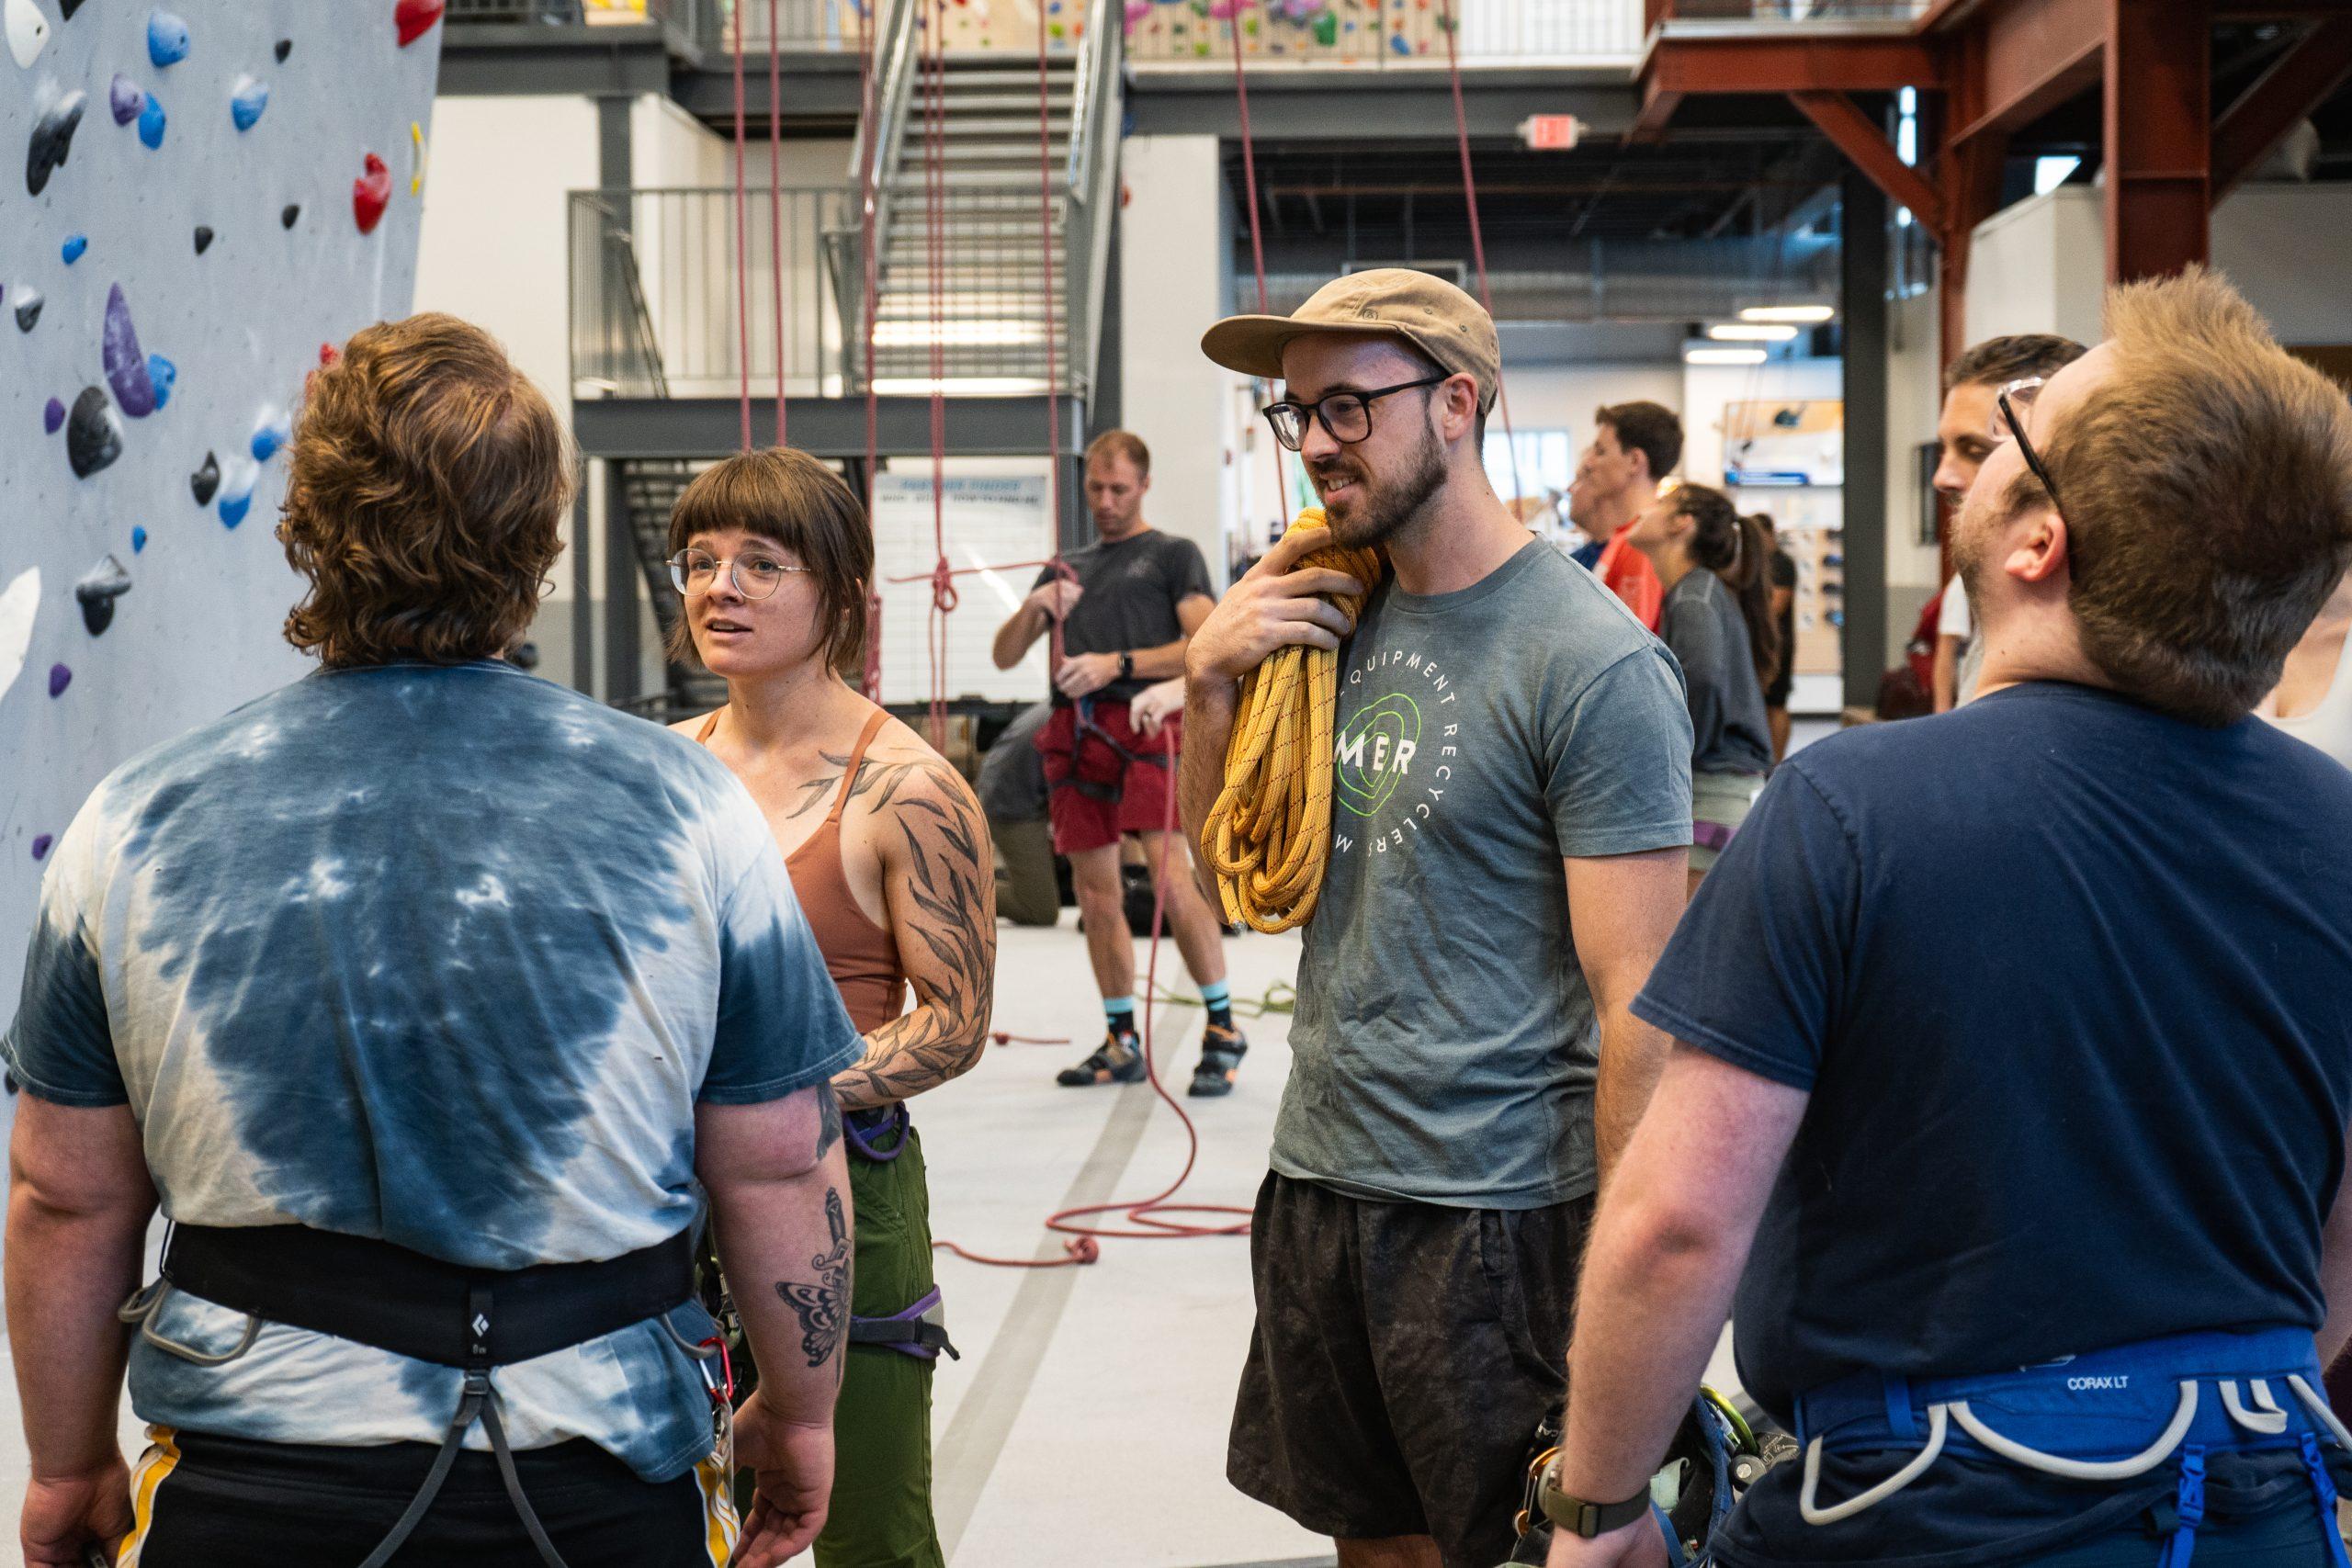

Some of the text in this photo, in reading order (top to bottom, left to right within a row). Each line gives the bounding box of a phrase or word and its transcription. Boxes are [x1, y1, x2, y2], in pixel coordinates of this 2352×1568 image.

[1339, 650, 1455, 705] QUIPMENT
[1333, 730, 1416, 774] MER
[2067, 1375, 2129, 1391] CORAX LT
